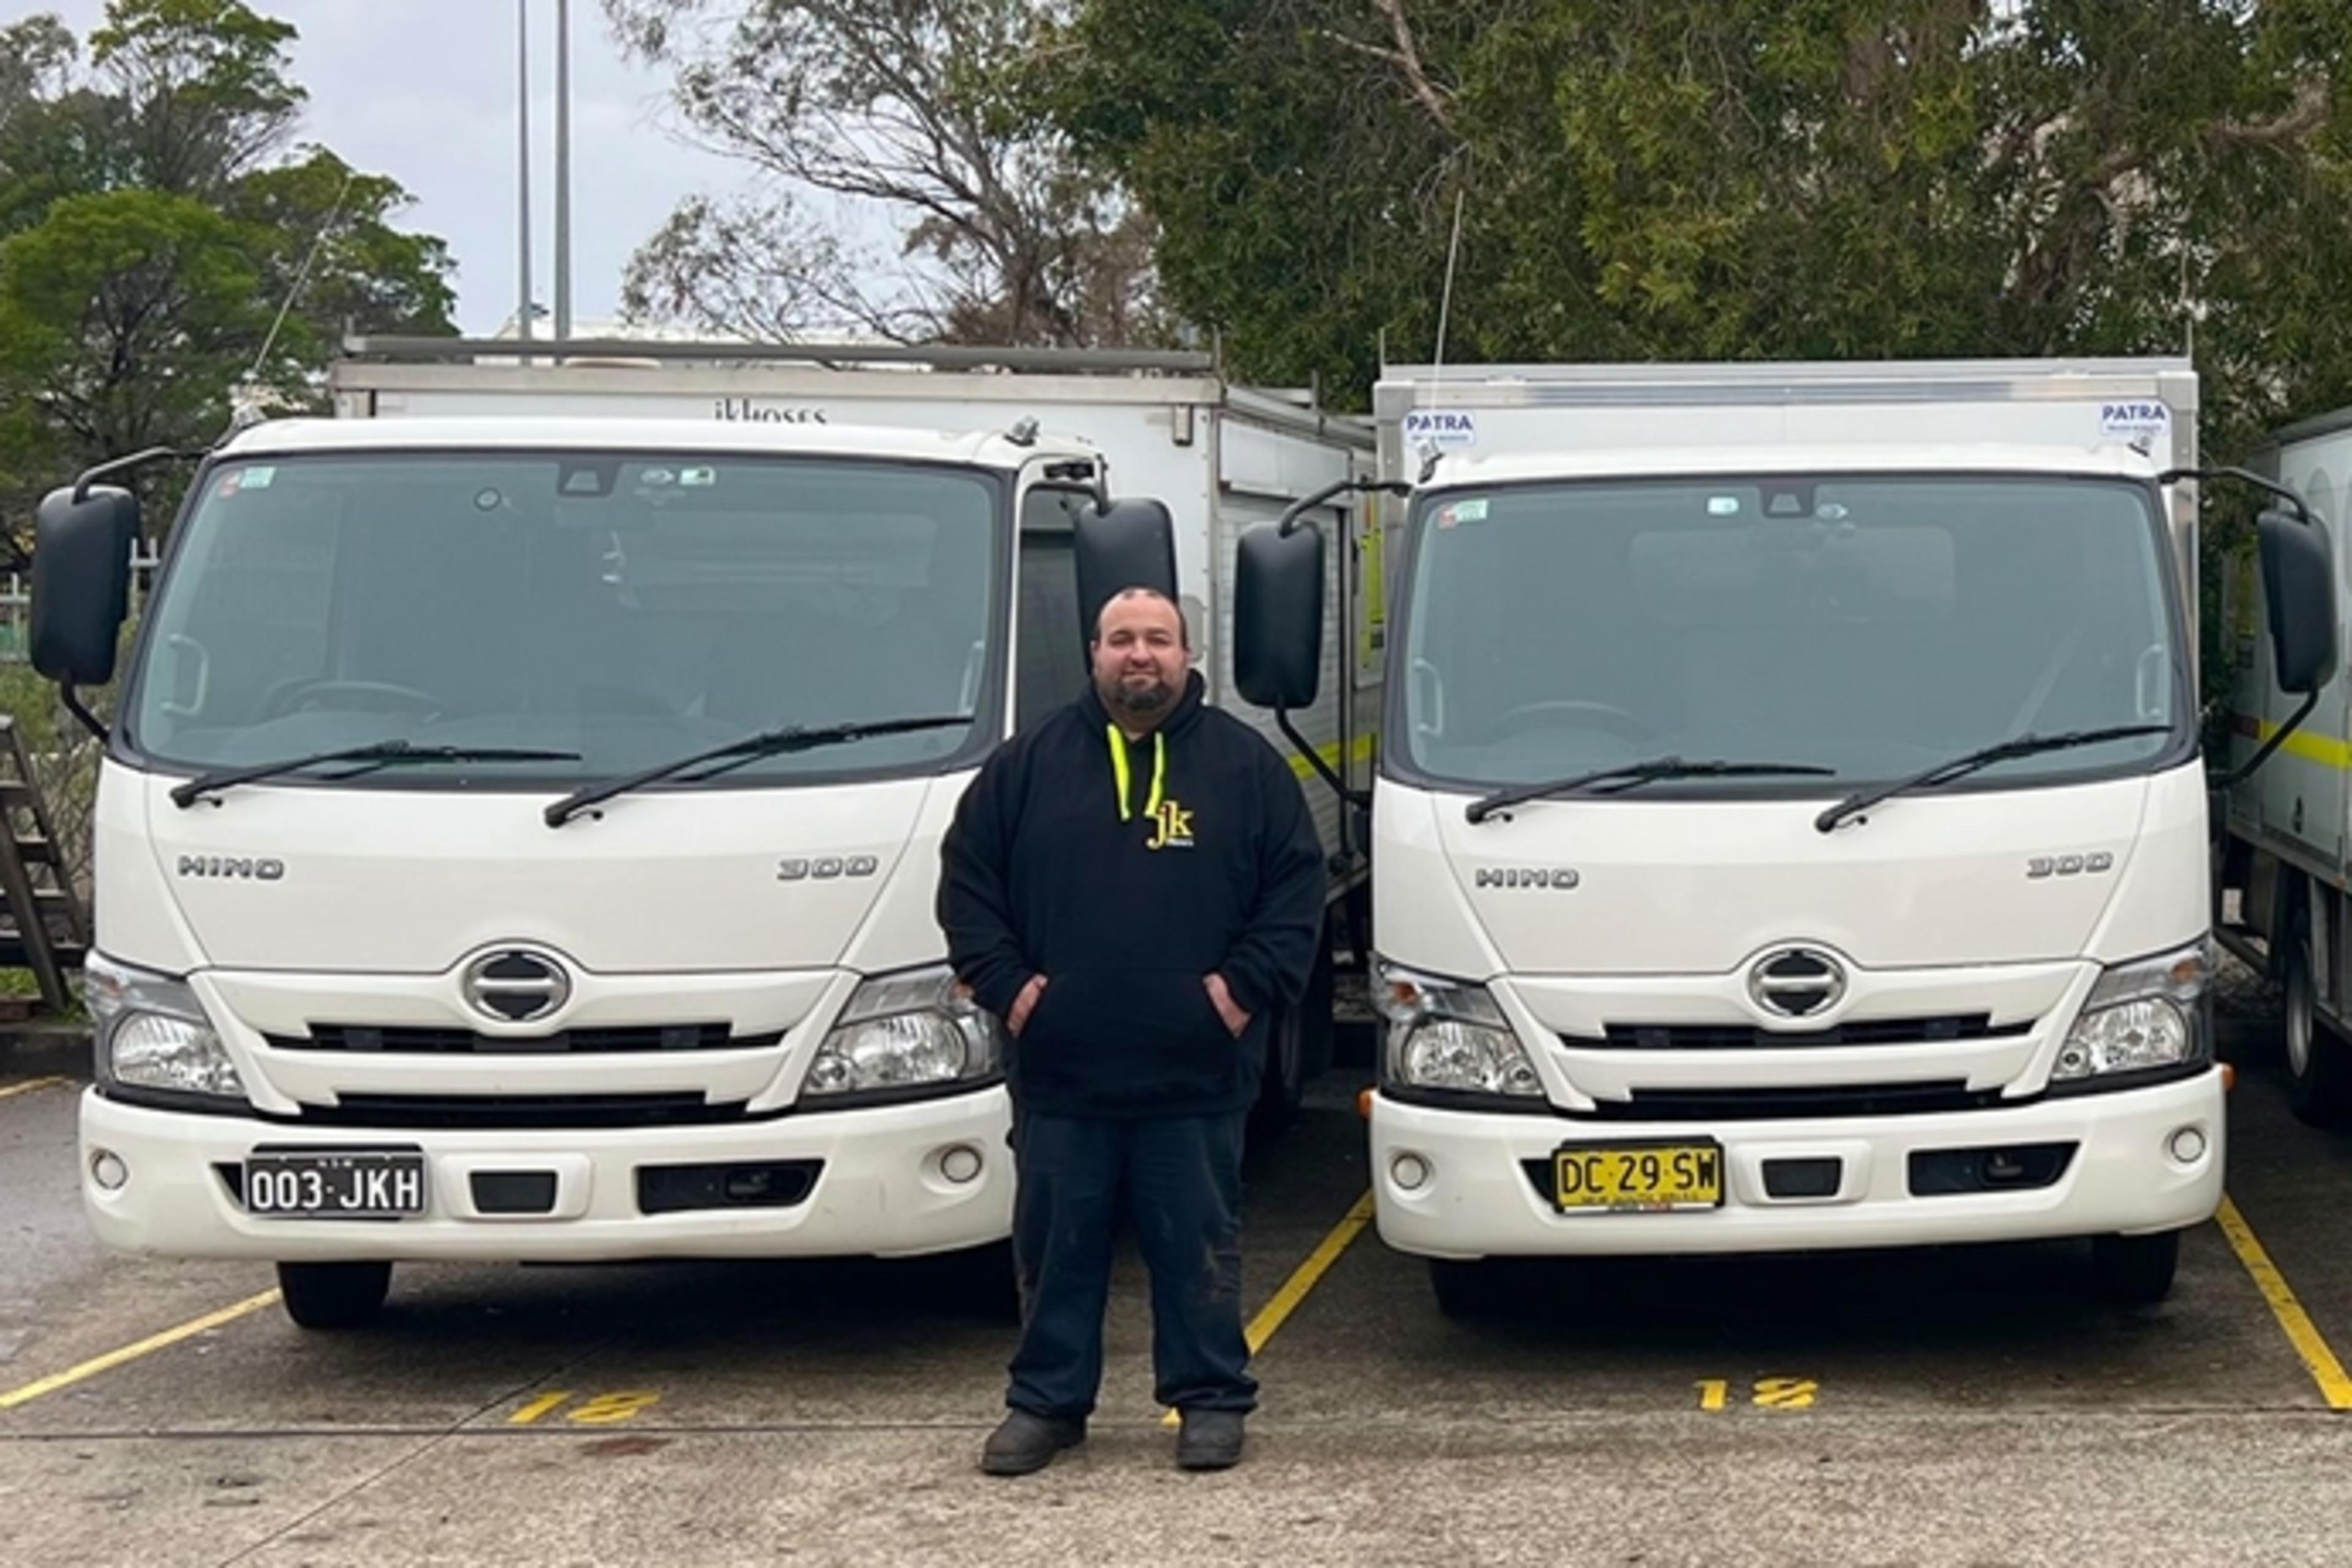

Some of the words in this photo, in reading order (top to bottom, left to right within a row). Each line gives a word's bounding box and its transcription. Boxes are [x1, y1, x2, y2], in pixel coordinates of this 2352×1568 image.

[1407, 415, 1474, 431] PATRA
[2102, 405, 2166, 420] PATRA
[1146, 800, 1194, 850] jk
[178, 855, 284, 880] HINO
[777, 856, 878, 880] 300
[2027, 851, 2114, 878] 300
[1476, 868, 1580, 890] HINO
